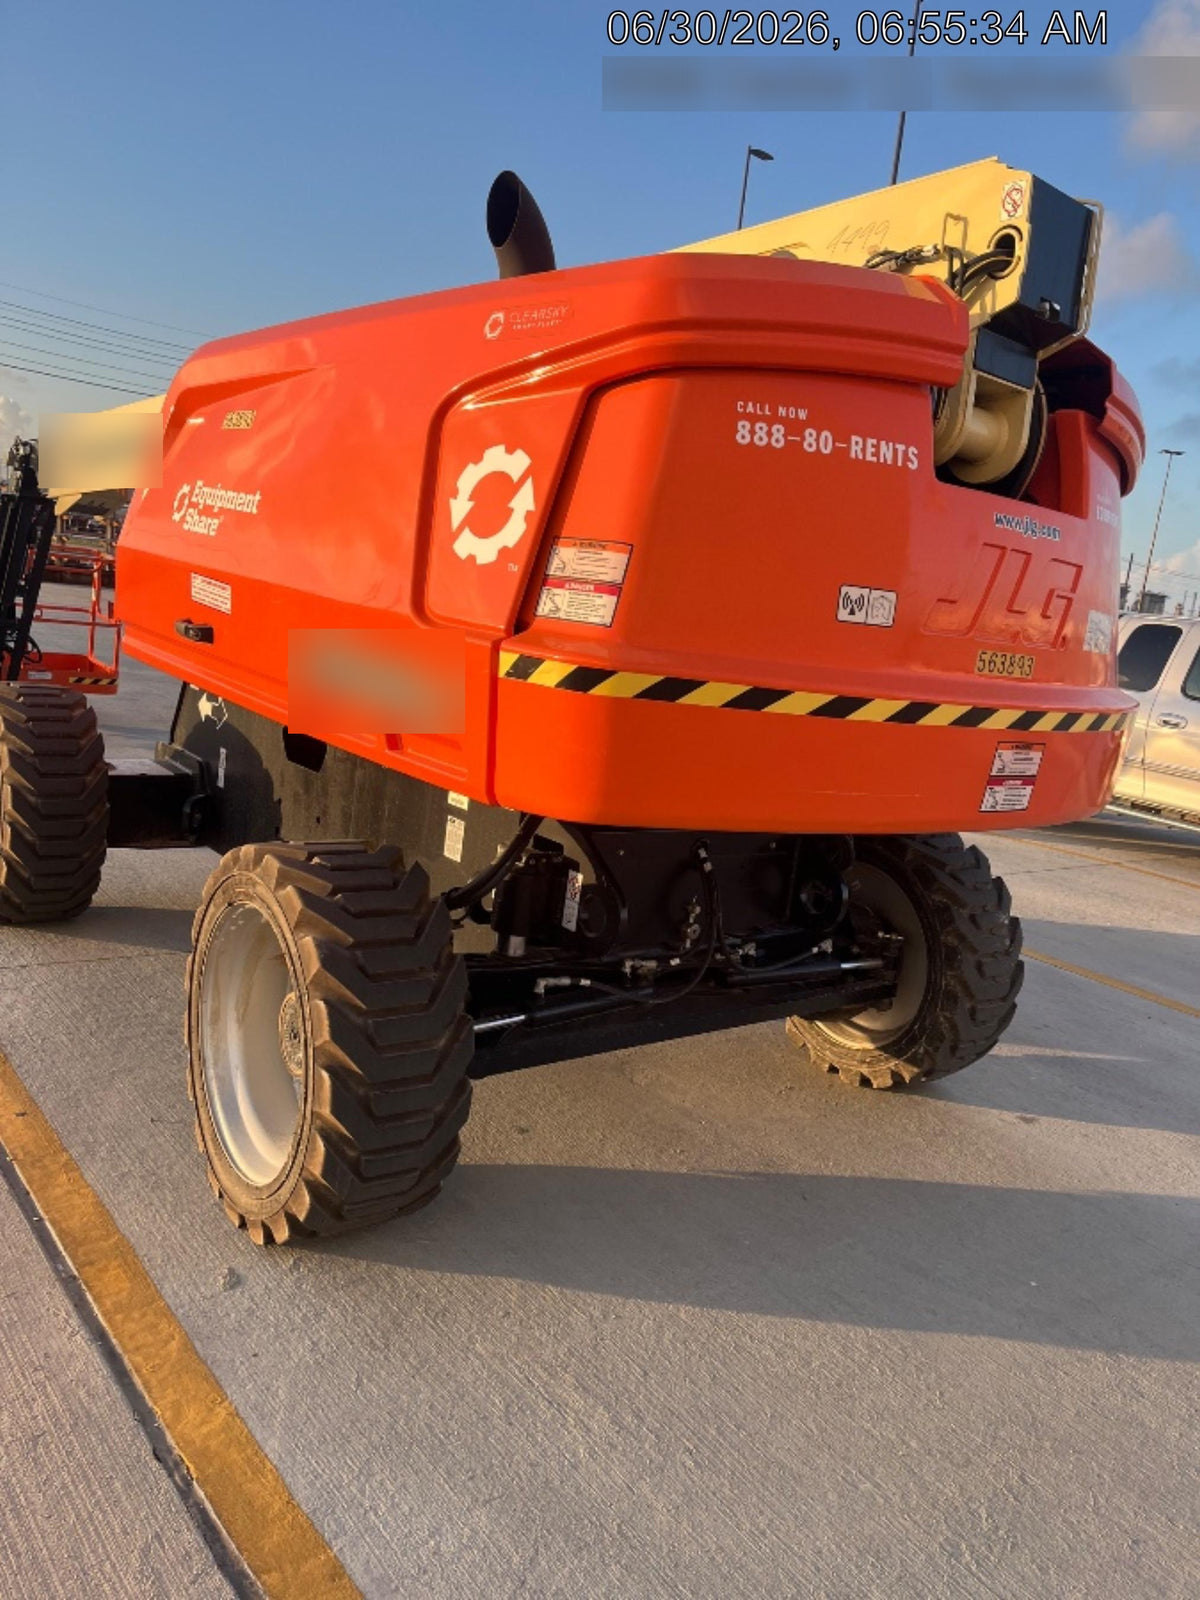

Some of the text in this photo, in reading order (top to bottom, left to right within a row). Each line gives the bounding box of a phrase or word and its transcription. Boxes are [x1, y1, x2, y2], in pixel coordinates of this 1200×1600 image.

[736, 401, 808, 420] CALL NOW
[735, 419, 920, 470] 888-80-RENTS
[191, 480, 262, 514] Equipment
[183, 508, 219, 537] Share
[994, 512, 1062, 541] www.jlg.com
[977, 651, 1034, 677] 563893
